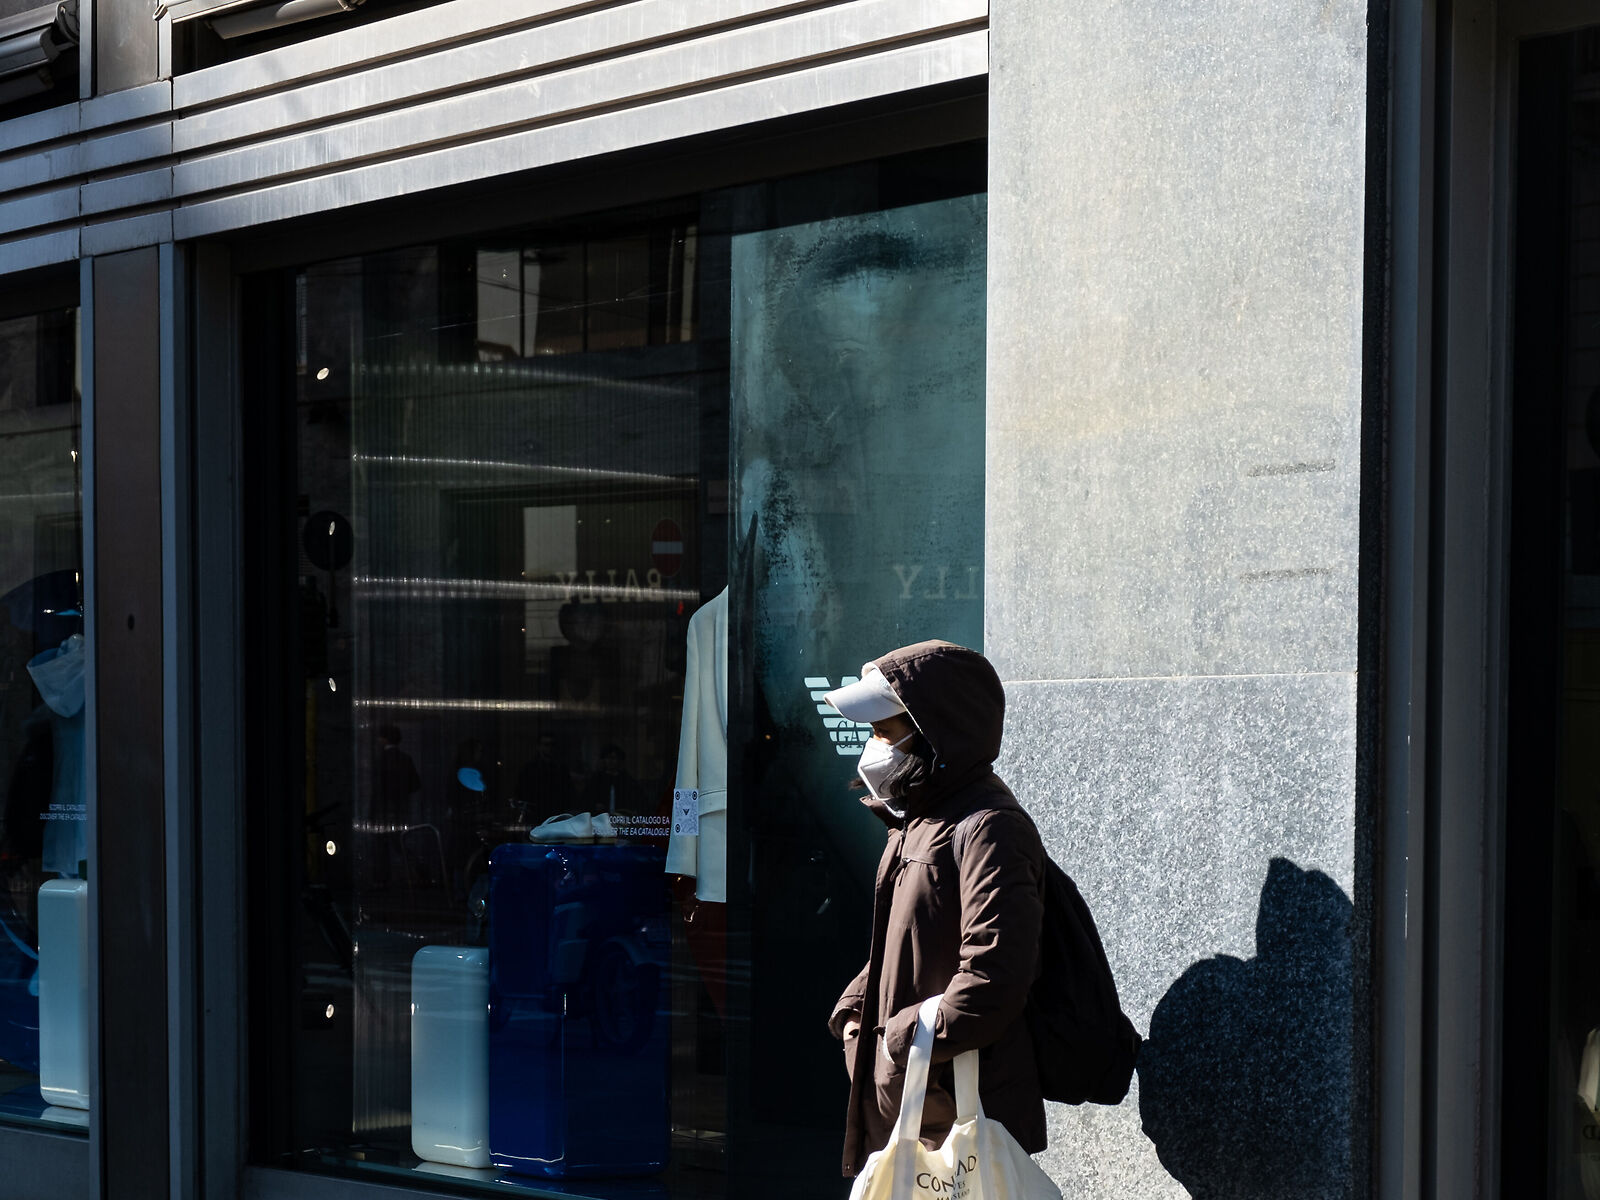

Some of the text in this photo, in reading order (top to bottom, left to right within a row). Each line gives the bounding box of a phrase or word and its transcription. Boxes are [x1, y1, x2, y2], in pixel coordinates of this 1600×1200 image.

[632, 816, 661, 824] CATALOGO
[662, 816, 670, 824] EA
[917, 1155, 977, 1193] CONAD
